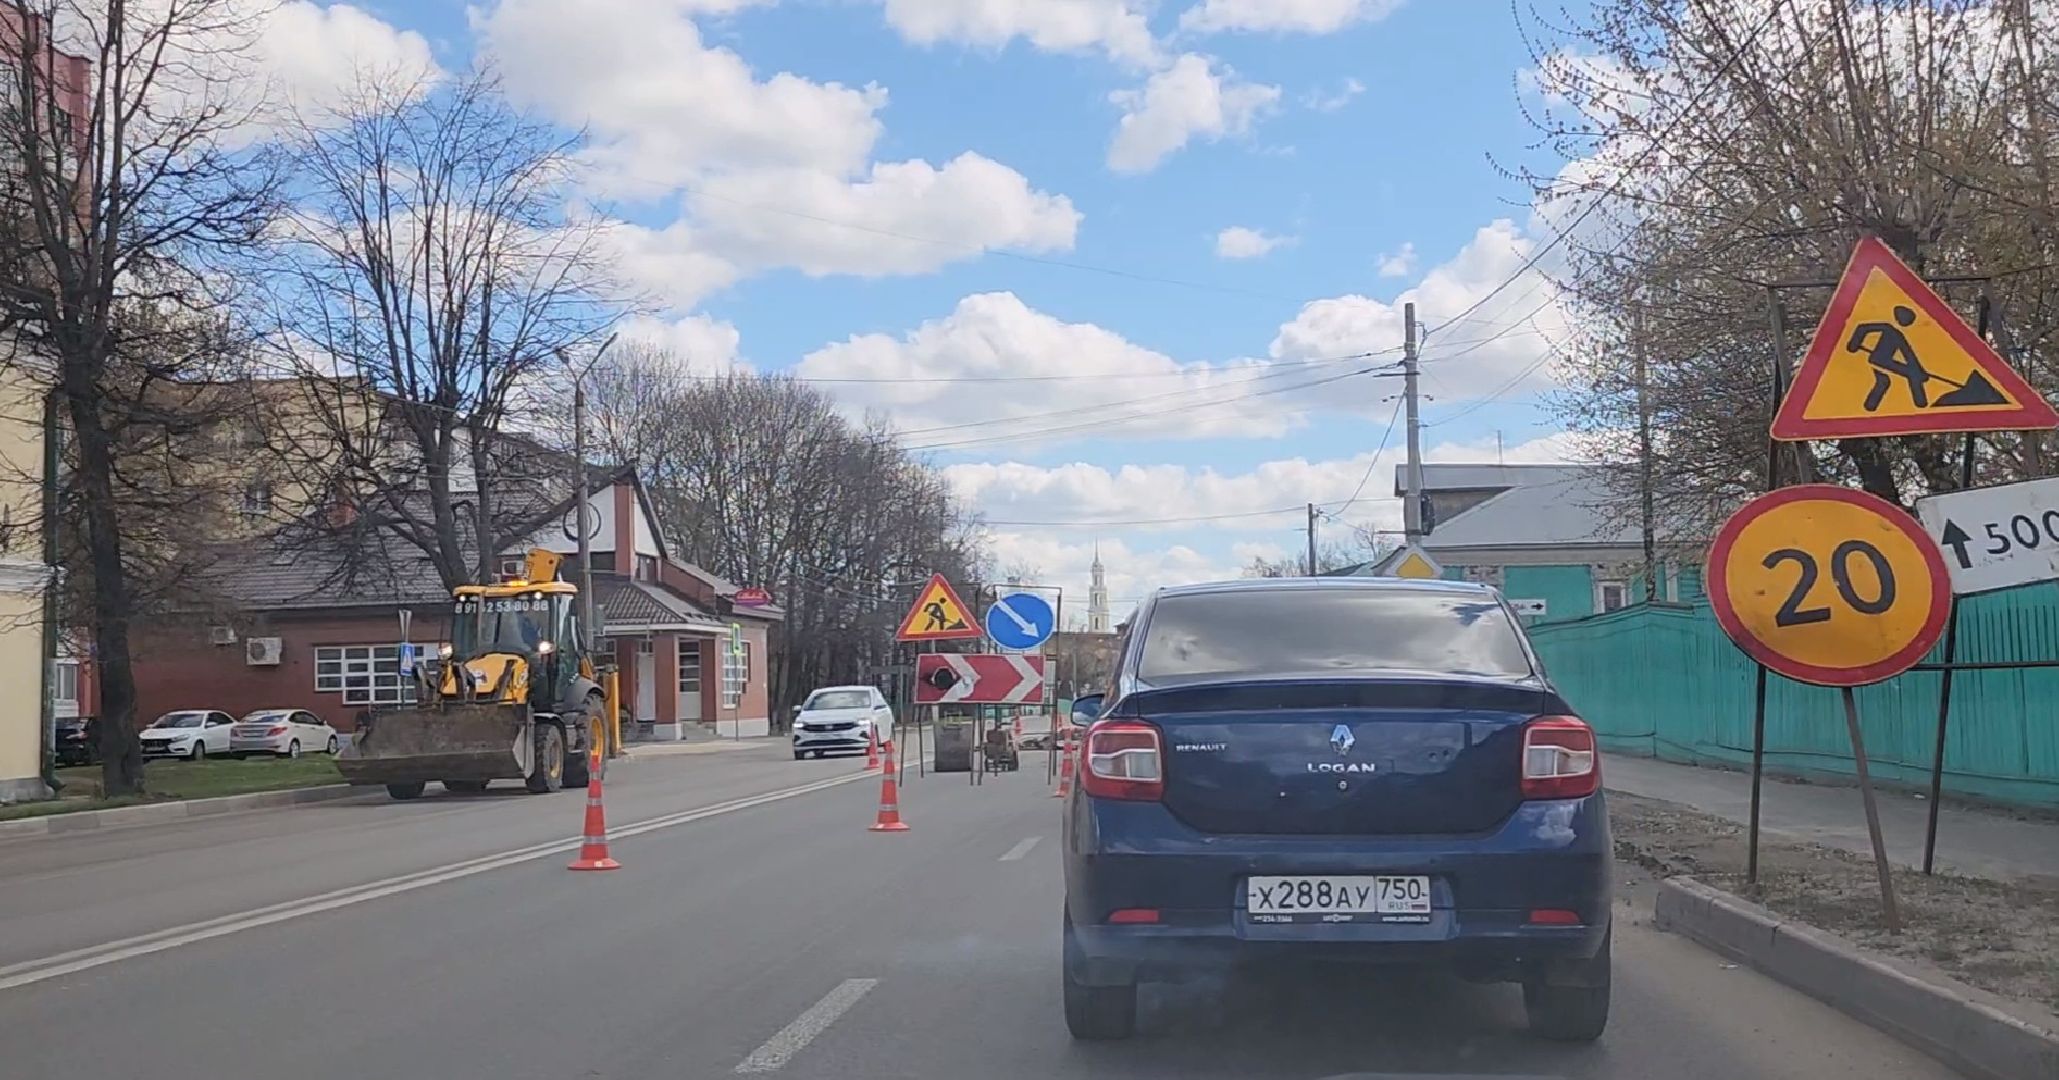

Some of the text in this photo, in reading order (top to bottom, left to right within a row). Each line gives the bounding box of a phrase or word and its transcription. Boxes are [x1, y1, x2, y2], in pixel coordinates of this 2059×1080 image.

[1984, 510, 2059, 555] 500
[1762, 539, 1896, 628] 20
[1175, 743, 1227, 752] RENAULT
[1307, 763, 1375, 773] LOGAN
[1378, 878, 1421, 900] 750
[1387, 901, 1410, 911] RUS
